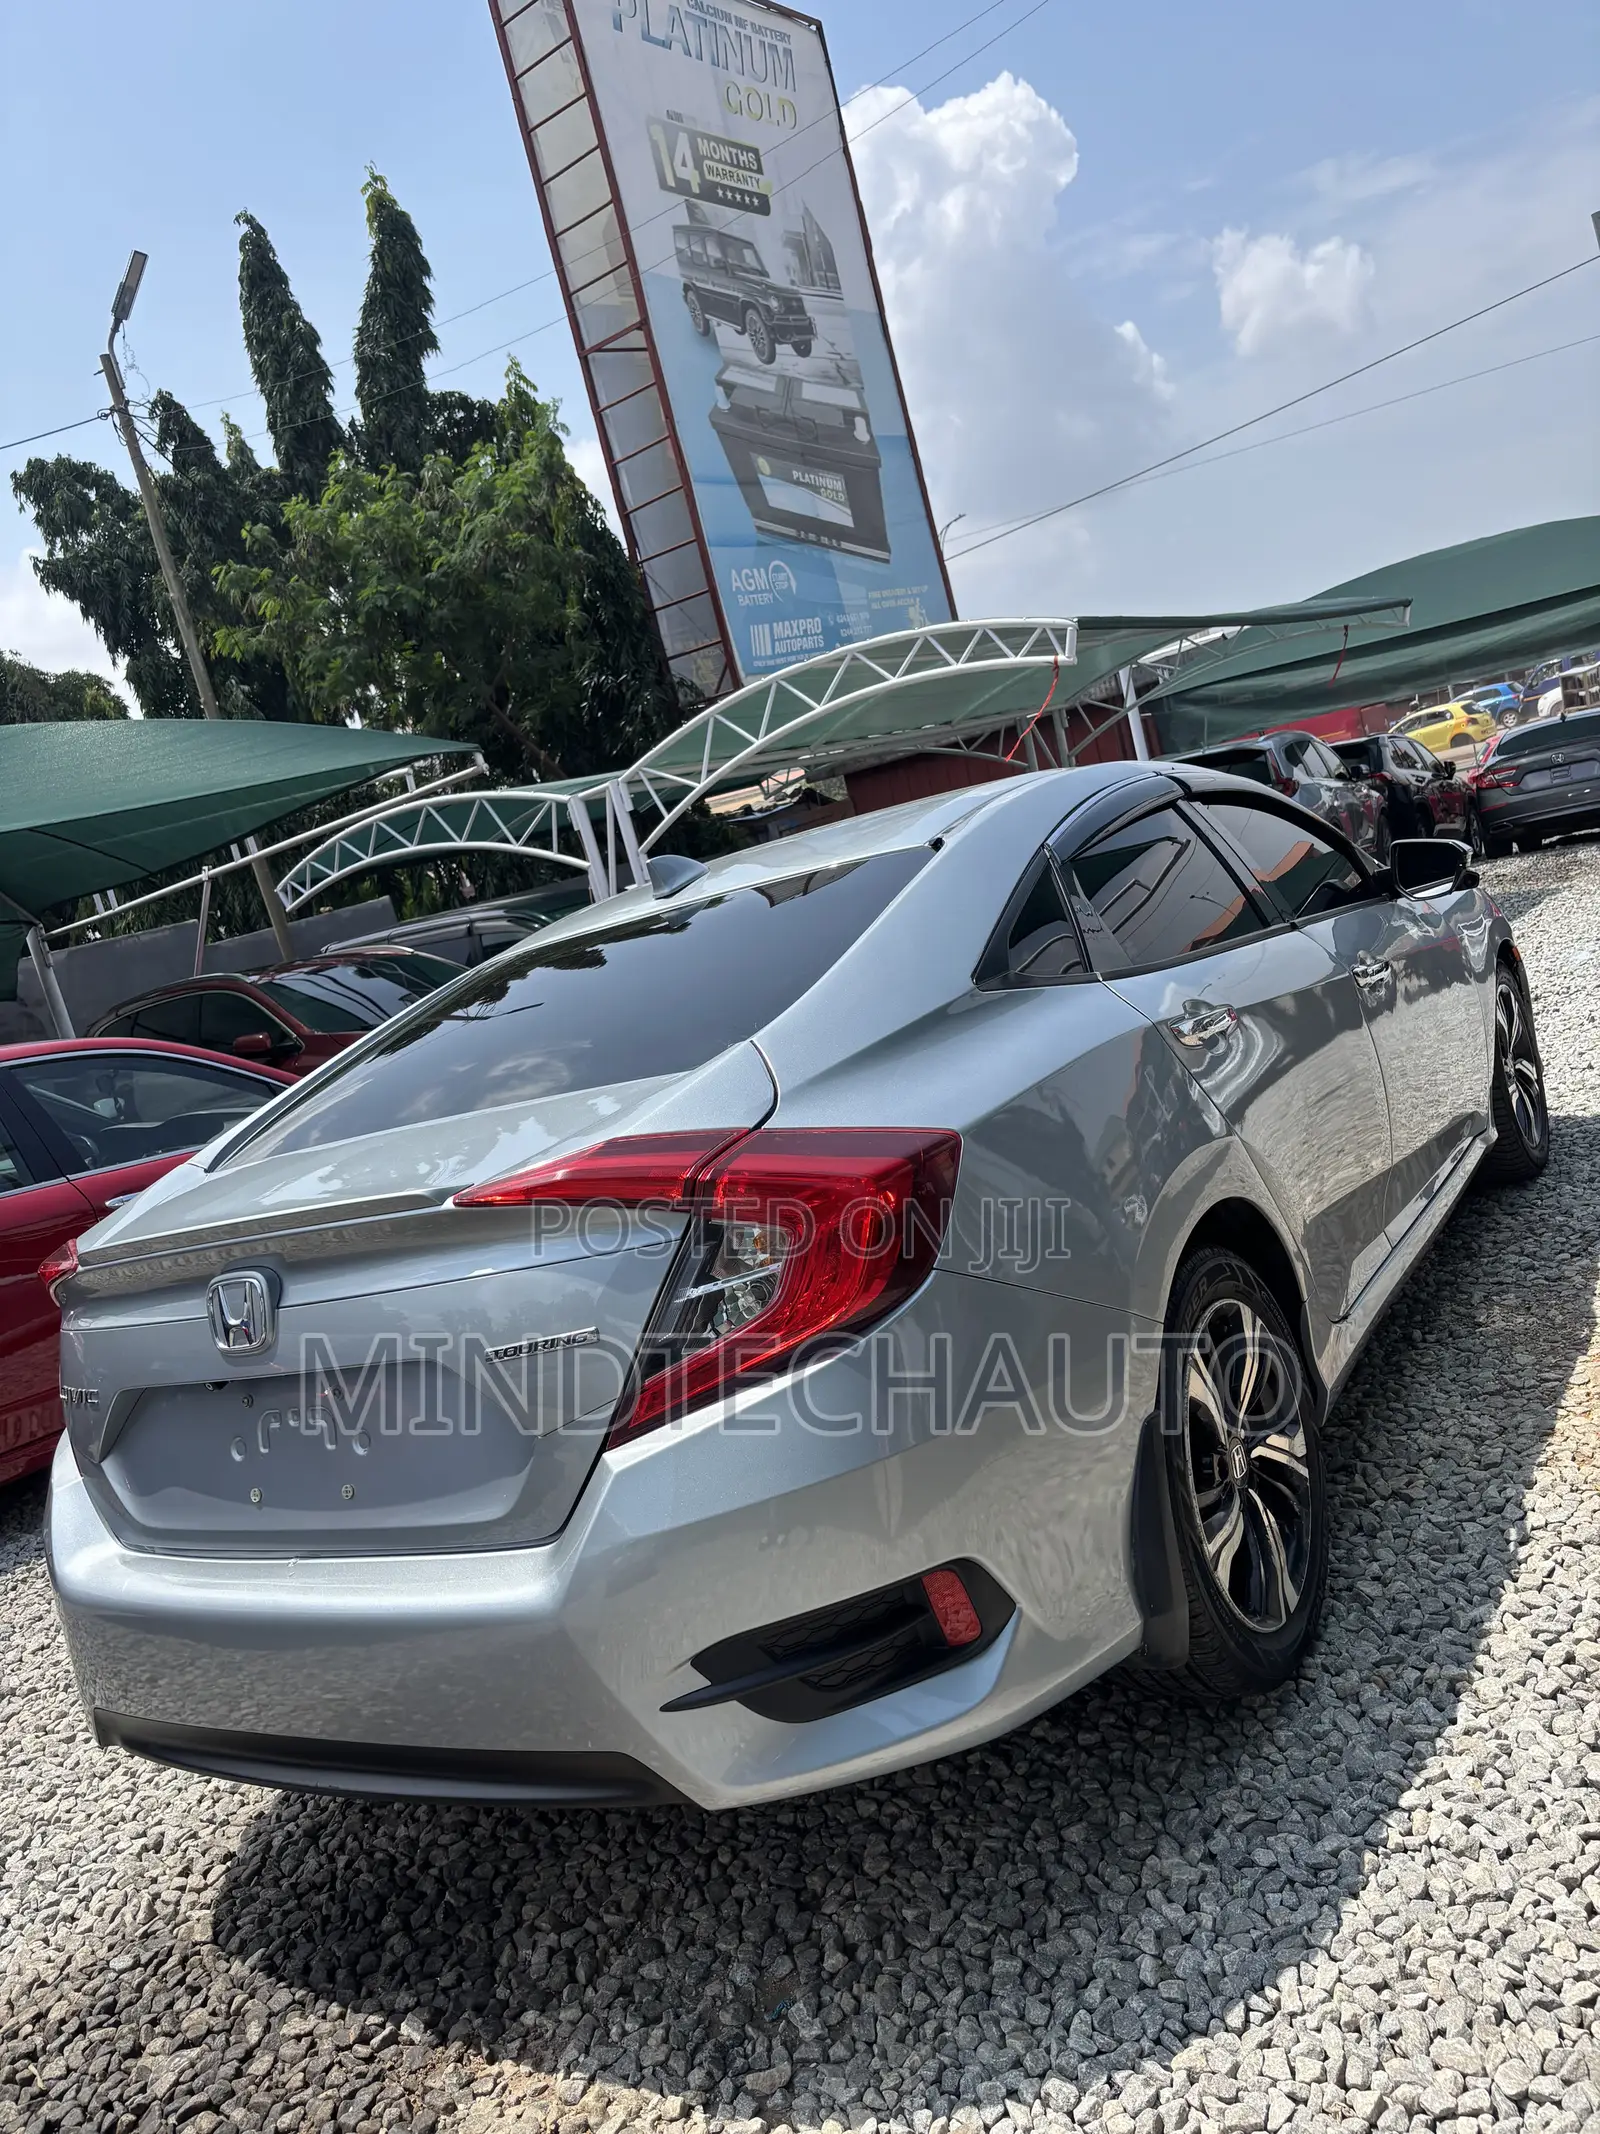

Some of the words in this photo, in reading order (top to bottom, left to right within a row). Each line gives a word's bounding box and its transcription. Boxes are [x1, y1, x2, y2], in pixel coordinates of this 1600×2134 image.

[687, 0, 733, 24] CALCIUM
[749, 21, 792, 45] BATTERY
[612, 0, 797, 92] PLATINUM
[724, 80, 797, 130] GOLD
[649, 124, 702, 194] 14
[697, 137, 758, 170] MONTHS
[705, 163, 760, 189] WARRANTY
[792, 470, 842, 491] PLATINUM
[820, 488, 845, 502] GOLD
[731, 567, 770, 592] AGM
[737, 593, 774, 607] BATTERY
[772, 617, 823, 640] MAXPRO
[774, 635, 825, 655] AUTOPARTS
[492, 1331, 588, 1361] TOURING
